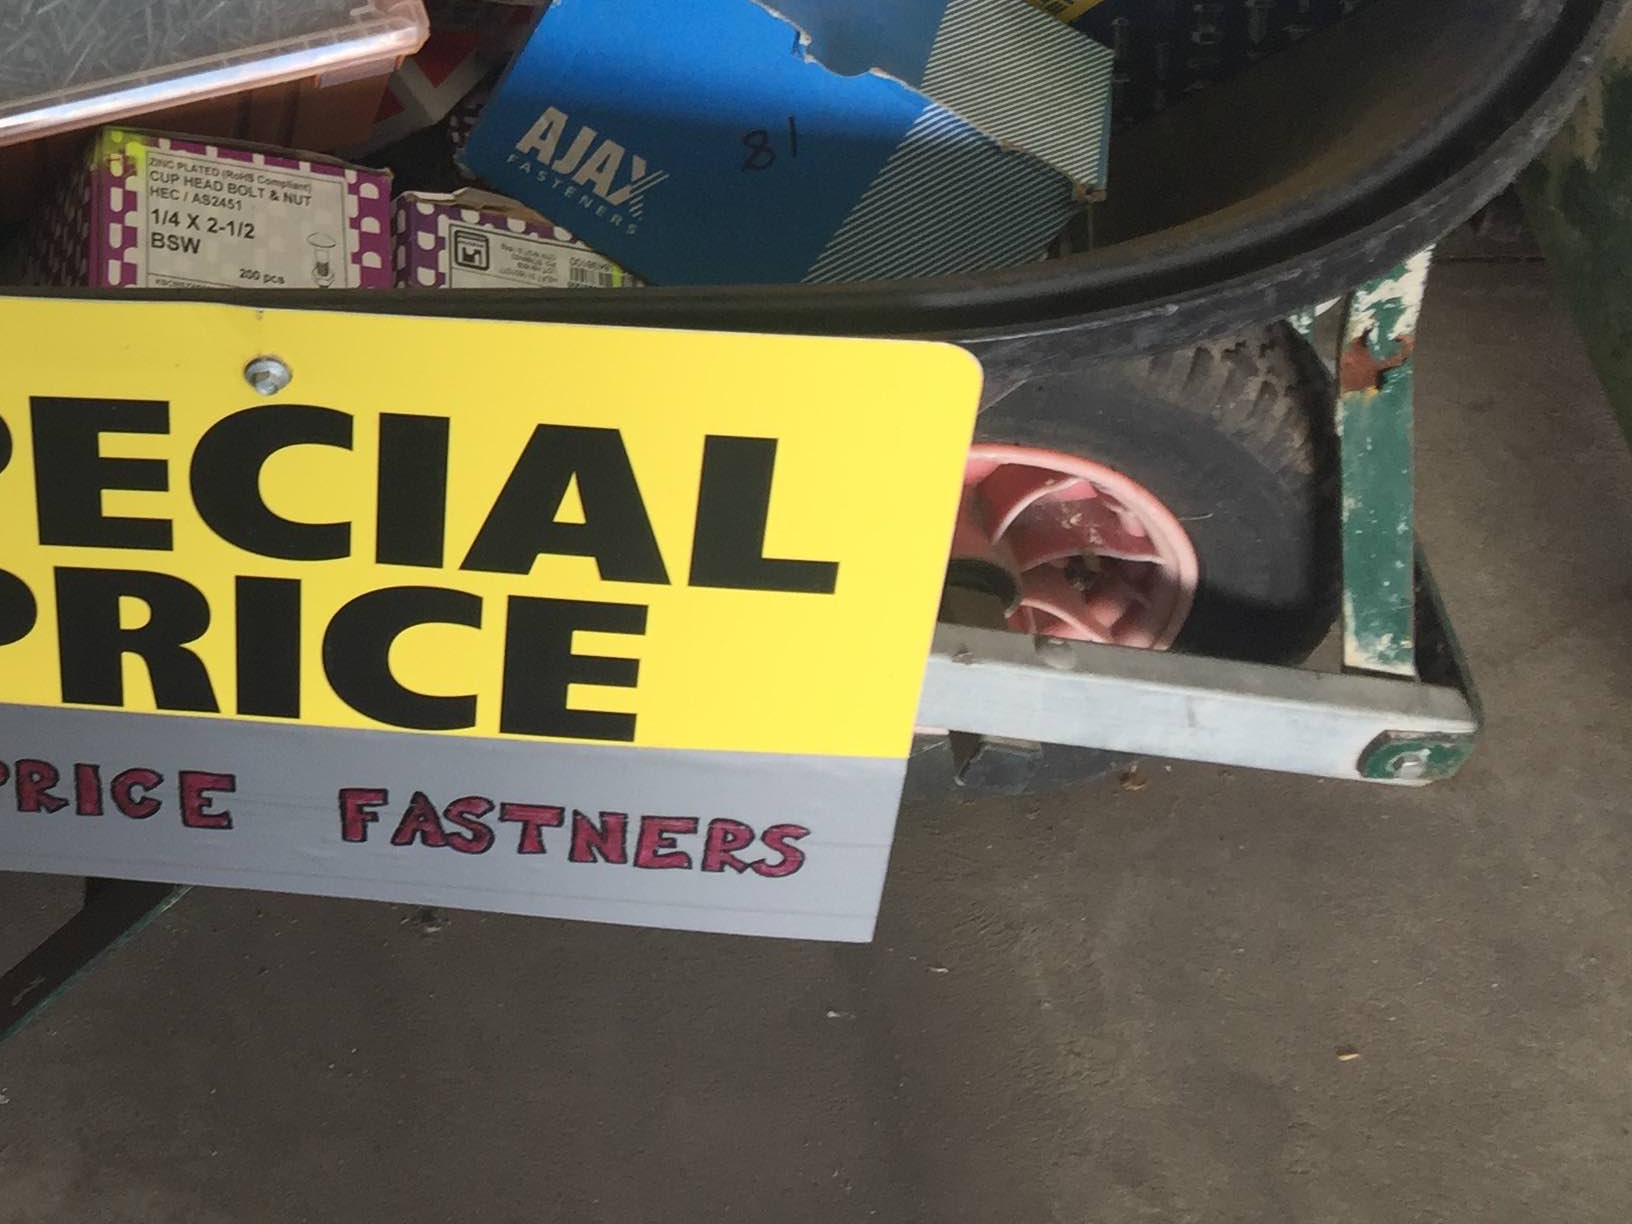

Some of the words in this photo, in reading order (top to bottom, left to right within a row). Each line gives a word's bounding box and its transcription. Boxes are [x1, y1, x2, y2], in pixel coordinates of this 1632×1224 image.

[176, 161, 221, 177] PLATED
[515, 105, 671, 216] AJAX
[149, 170, 181, 185] CUP
[183, 175, 225, 193] HEAD
[226, 181, 266, 199] BOLT
[269, 188, 281, 202] &
[283, 191, 313, 207] NUT
[149, 186, 180, 202] HEC
[191, 192, 244, 212] AS2451
[506, 153, 639, 236] FASTENERS
[151, 208, 181, 228] 1/4
[186, 212, 201, 231] X
[206, 216, 257, 241] 2-1/2
[150, 231, 202, 255] BSW
[337, 787, 815, 878] FASTNERS
